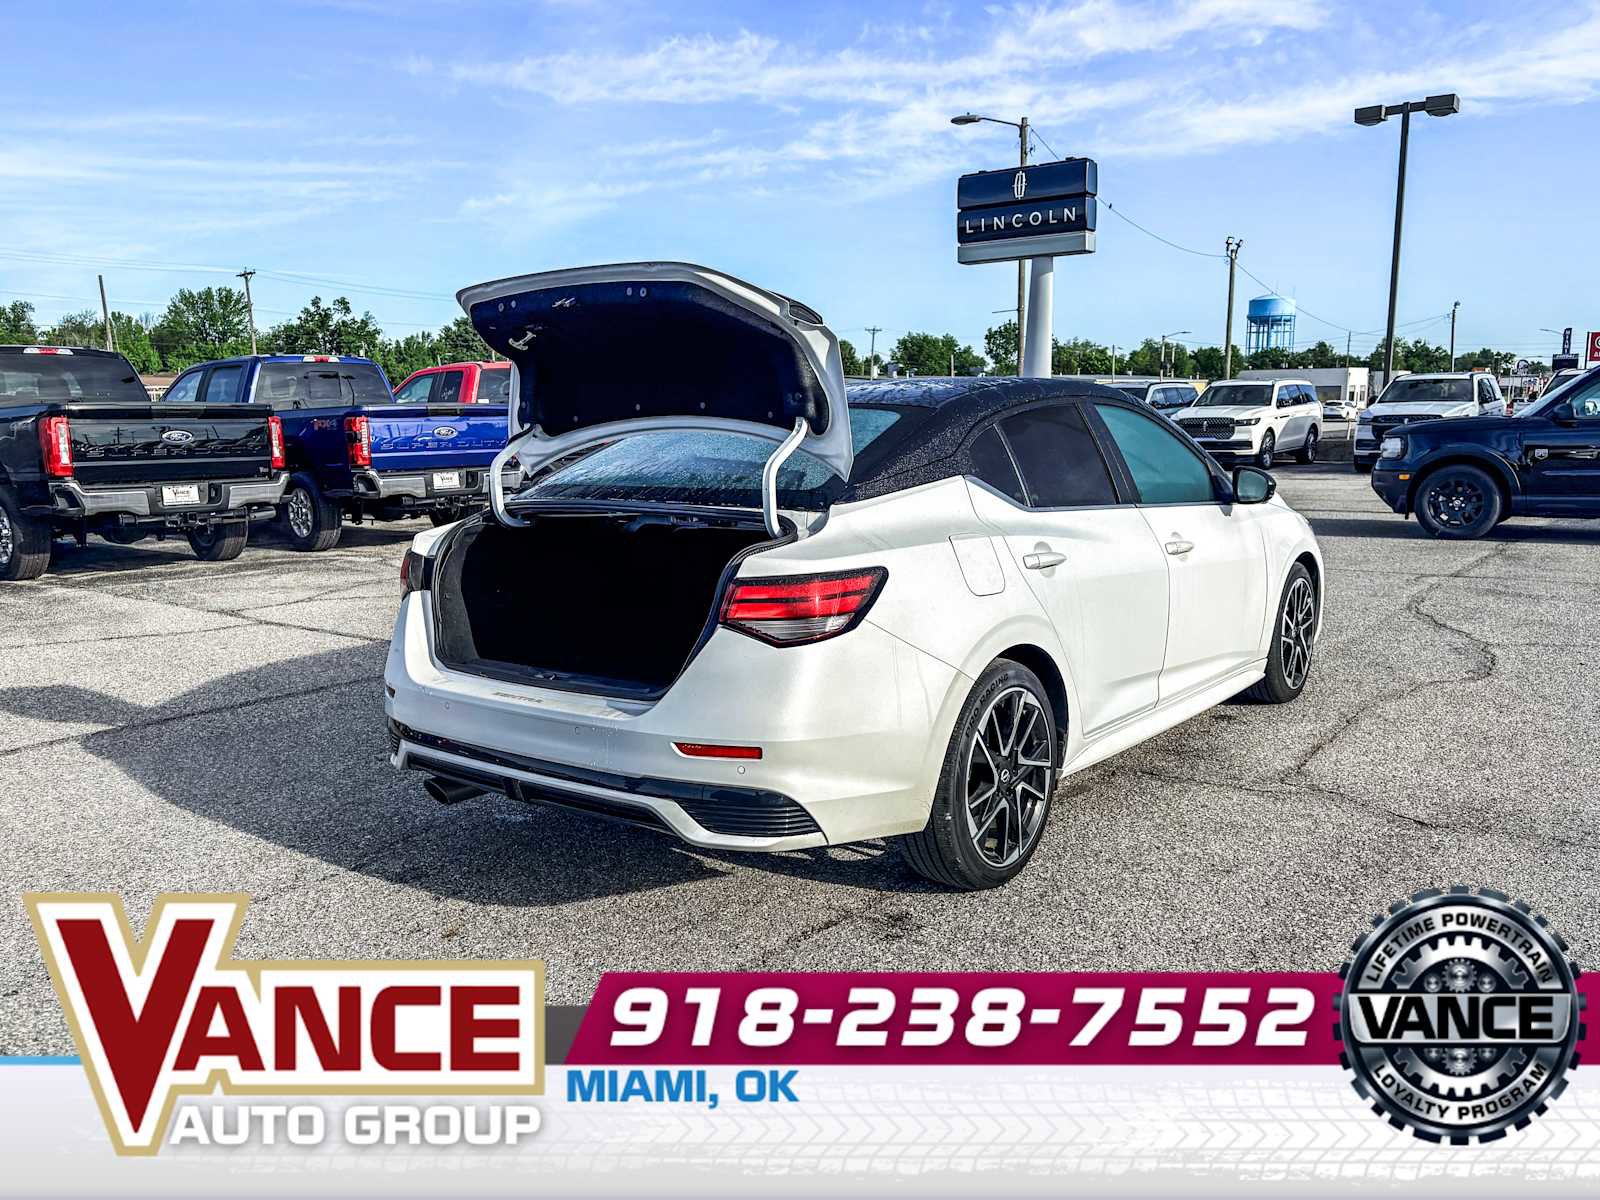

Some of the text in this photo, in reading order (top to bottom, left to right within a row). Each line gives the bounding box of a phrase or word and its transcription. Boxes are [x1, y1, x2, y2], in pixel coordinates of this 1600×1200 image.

[966, 207, 1076, 234] LINCOLN
[165, 431, 191, 443] Ford
[380, 441, 452, 450] SUPER
[86, 448, 188, 458] SUPER
[979, 672, 1009, 705] RACING
